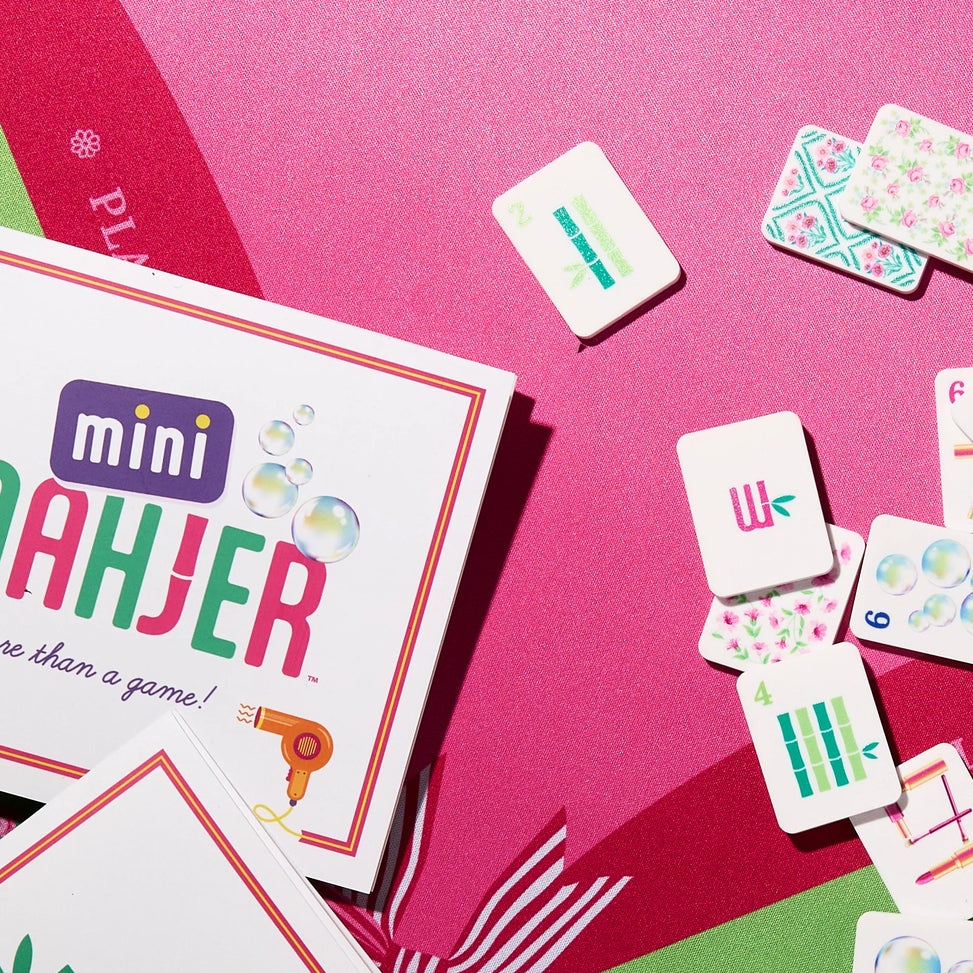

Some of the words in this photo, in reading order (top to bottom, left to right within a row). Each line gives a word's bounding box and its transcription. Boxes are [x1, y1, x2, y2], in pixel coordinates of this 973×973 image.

[89, 186, 149, 265] PL
[508, 200, 532, 228] 2
[72, 403, 211, 480] mini
[0, 639, 25, 658] re
[28, 641, 97, 678] than
[102, 670, 122, 685] a
[121, 677, 218, 709] game!
[754, 679, 774, 706] 4
